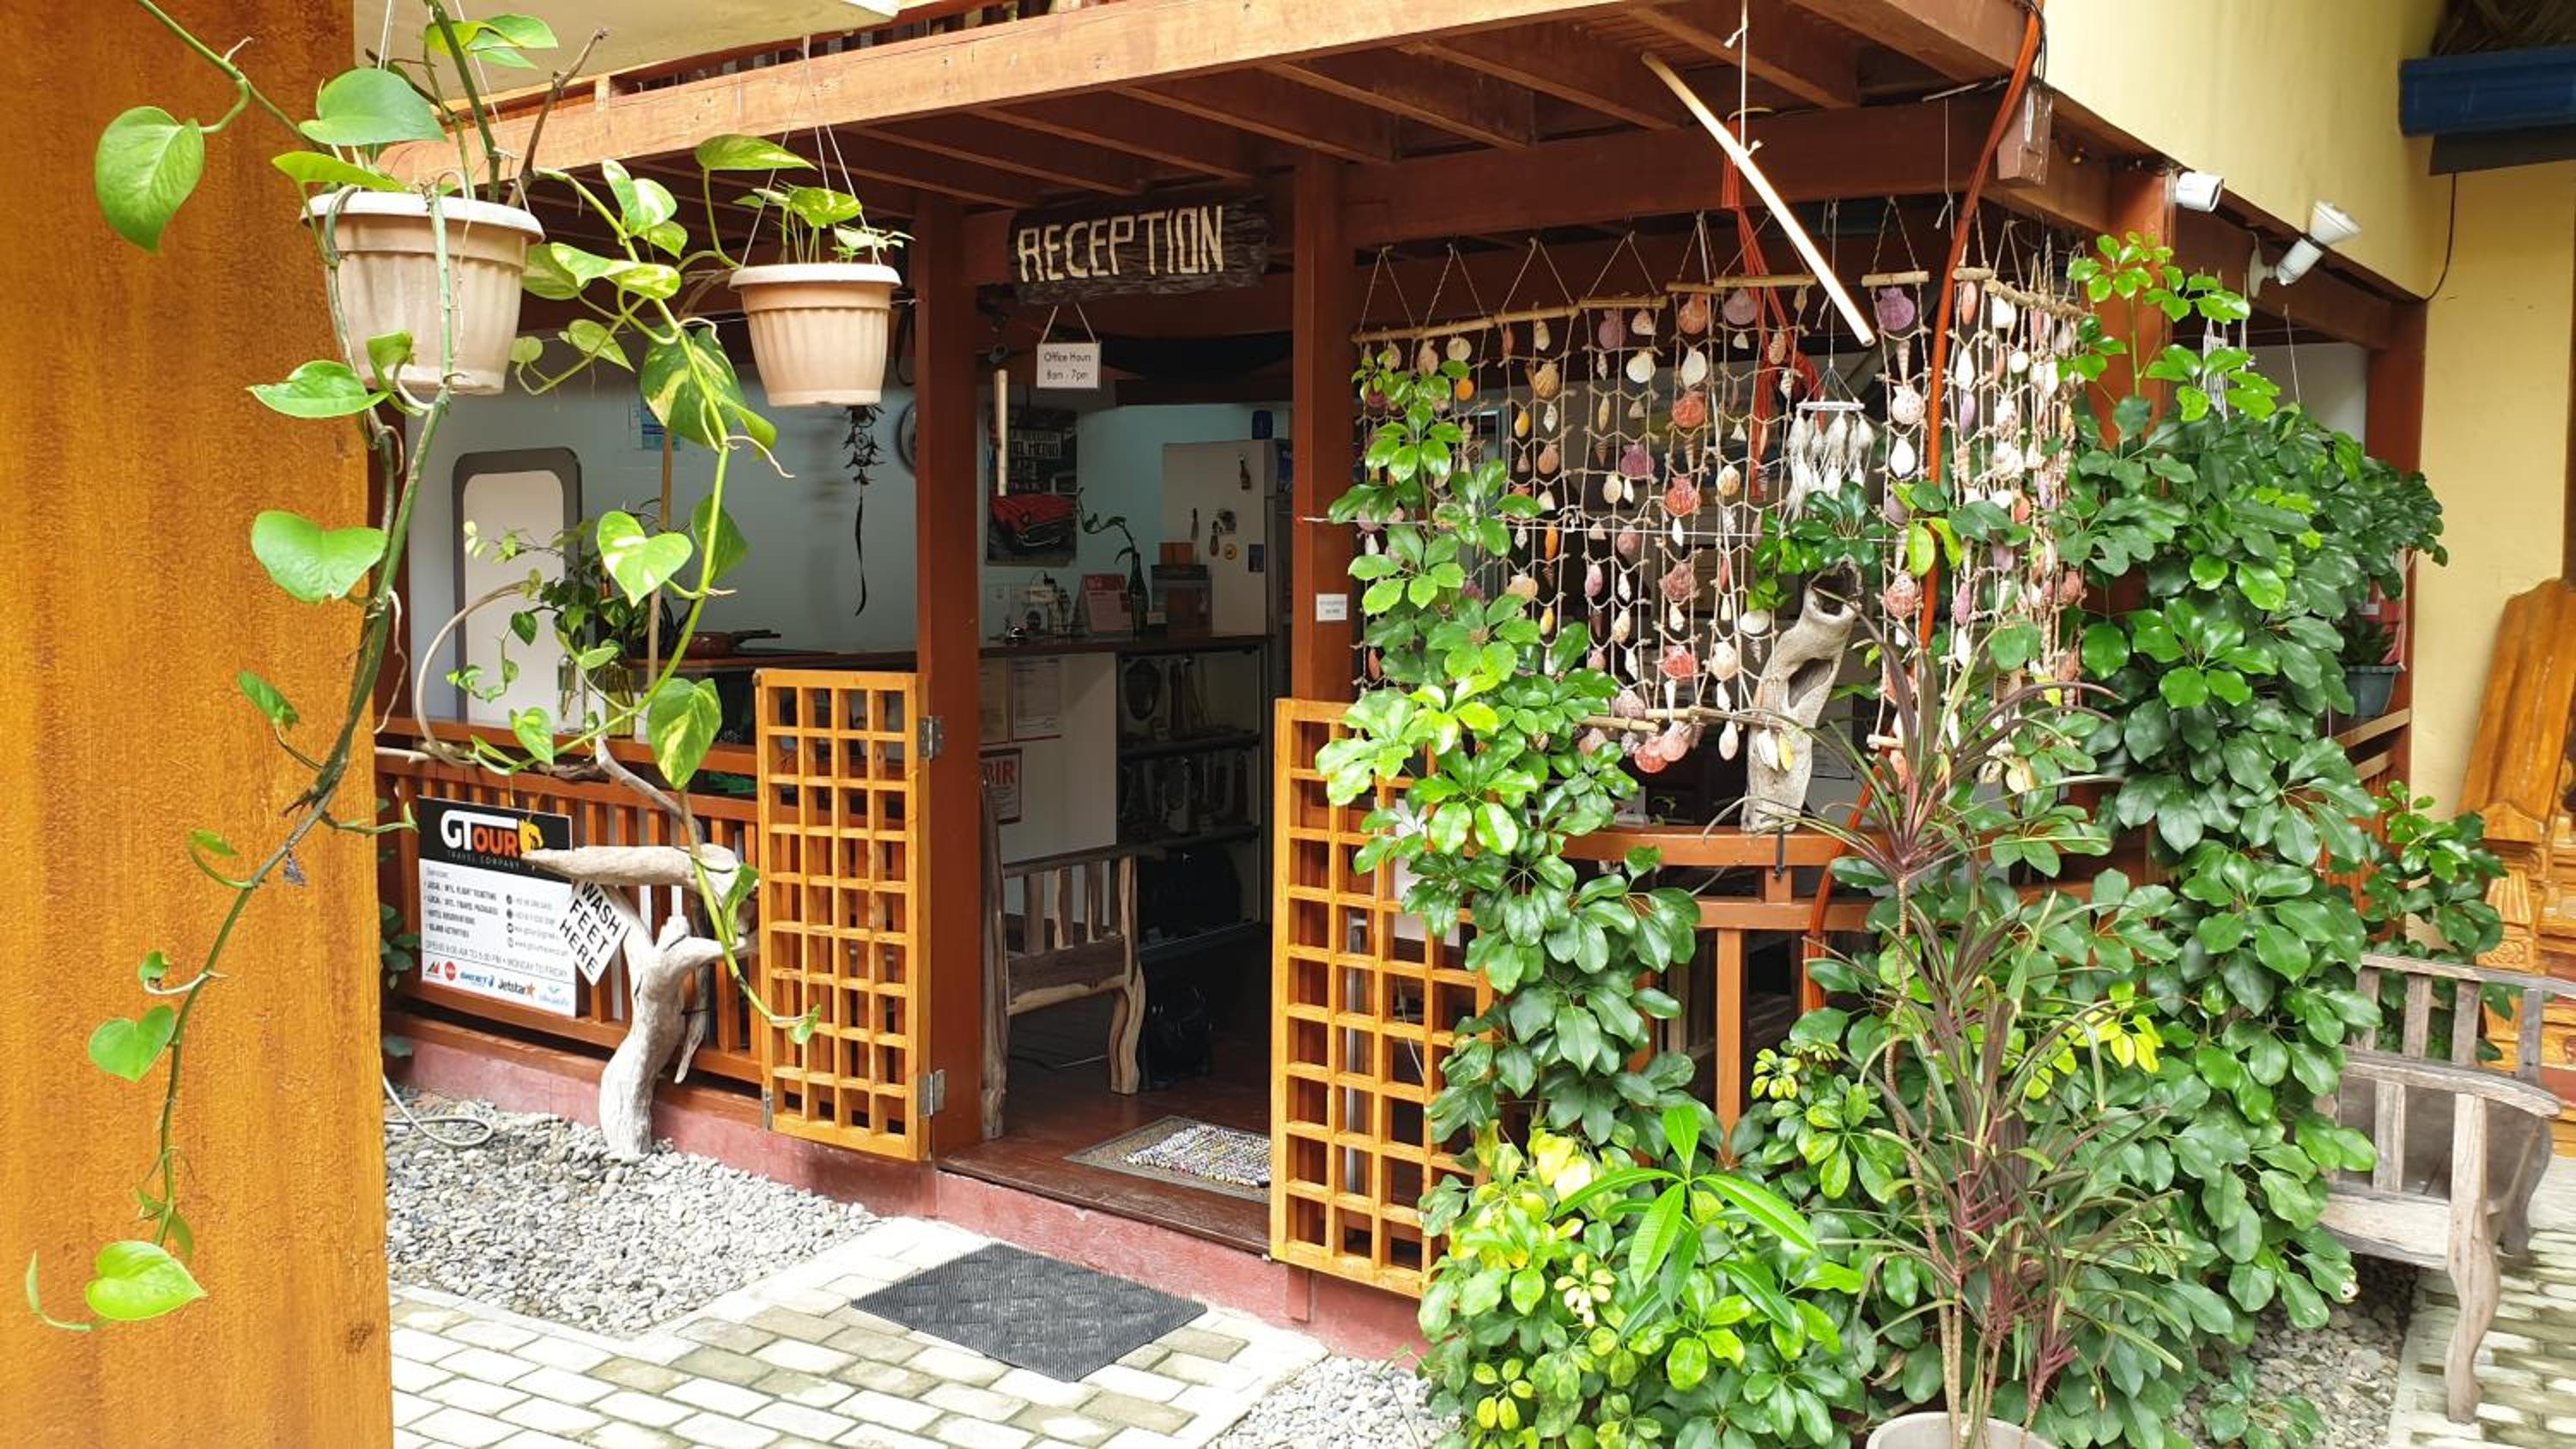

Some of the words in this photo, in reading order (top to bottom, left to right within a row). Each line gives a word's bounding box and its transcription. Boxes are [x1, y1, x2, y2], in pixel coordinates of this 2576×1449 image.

[1017, 205, 1224, 283] RECEPTION
[1044, 351, 1067, 362] Office
[1072, 369, 1090, 382] 7pm
[447, 851, 476, 864] TRAVEL
[480, 855, 520, 870] COMPANY
[569, 899, 610, 954] FEET
[581, 881, 621, 937] WASH
[559, 918, 598, 976] HERE
[498, 978, 526, 995] Jetstar
